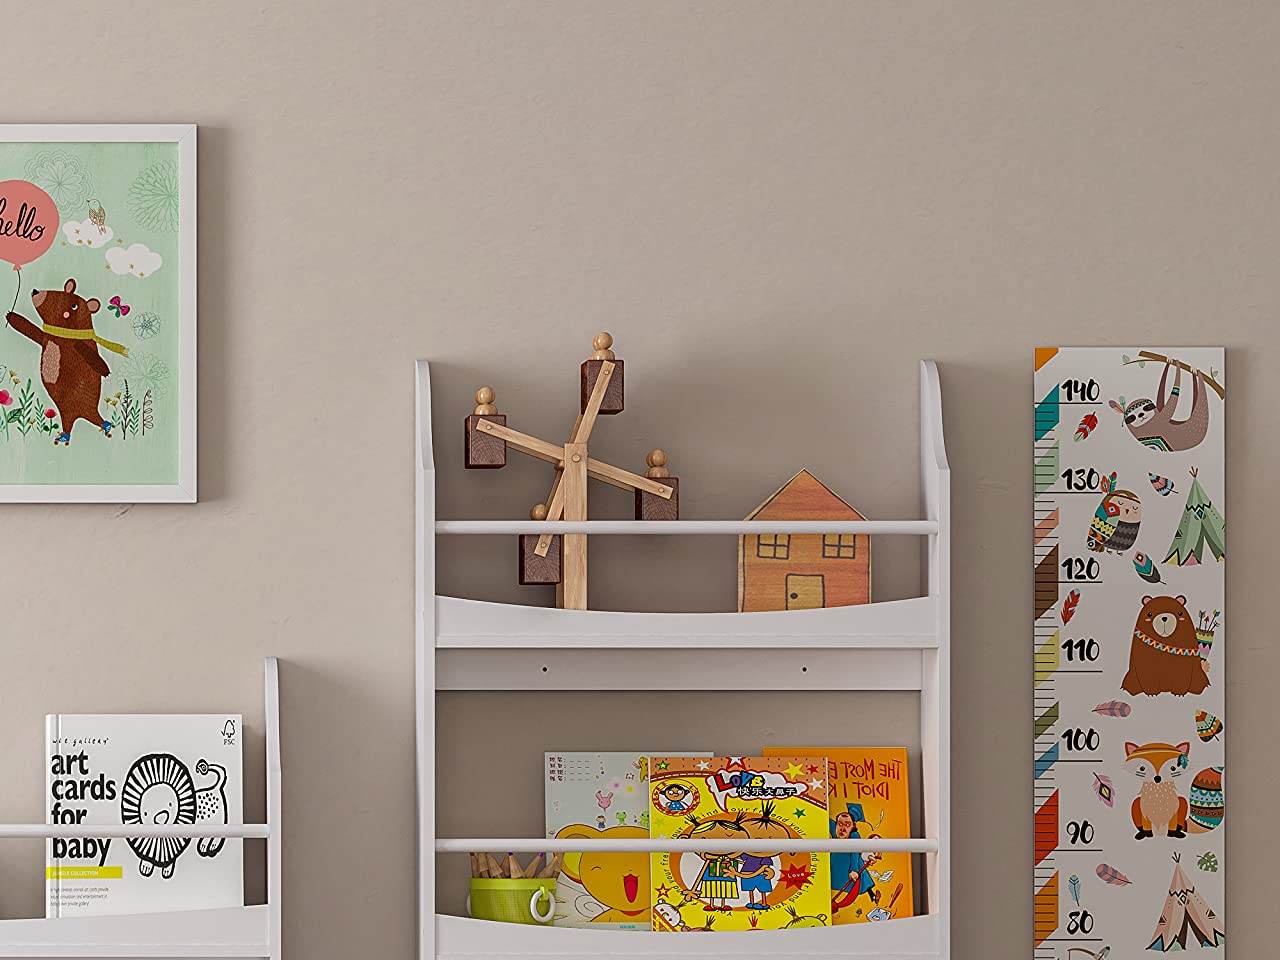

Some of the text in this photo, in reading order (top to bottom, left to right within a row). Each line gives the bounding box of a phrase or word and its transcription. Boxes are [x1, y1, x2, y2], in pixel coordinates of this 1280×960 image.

[1061, 379, 1099, 401] 140
[1061, 468, 1099, 491] 130
[1061, 557, 1099, 580] 120
[1061, 639, 1099, 661] 110
[1061, 728, 1099, 751] 100
[51, 750, 89, 775] art
[51, 773, 117, 800] cards
[737, 787, 797, 797] 快乐大鼻子
[51, 803, 87, 825] for
[1066, 820, 1094, 846] 90
[52, 838, 111, 867] baby
[1066, 910, 1095, 936] 80
